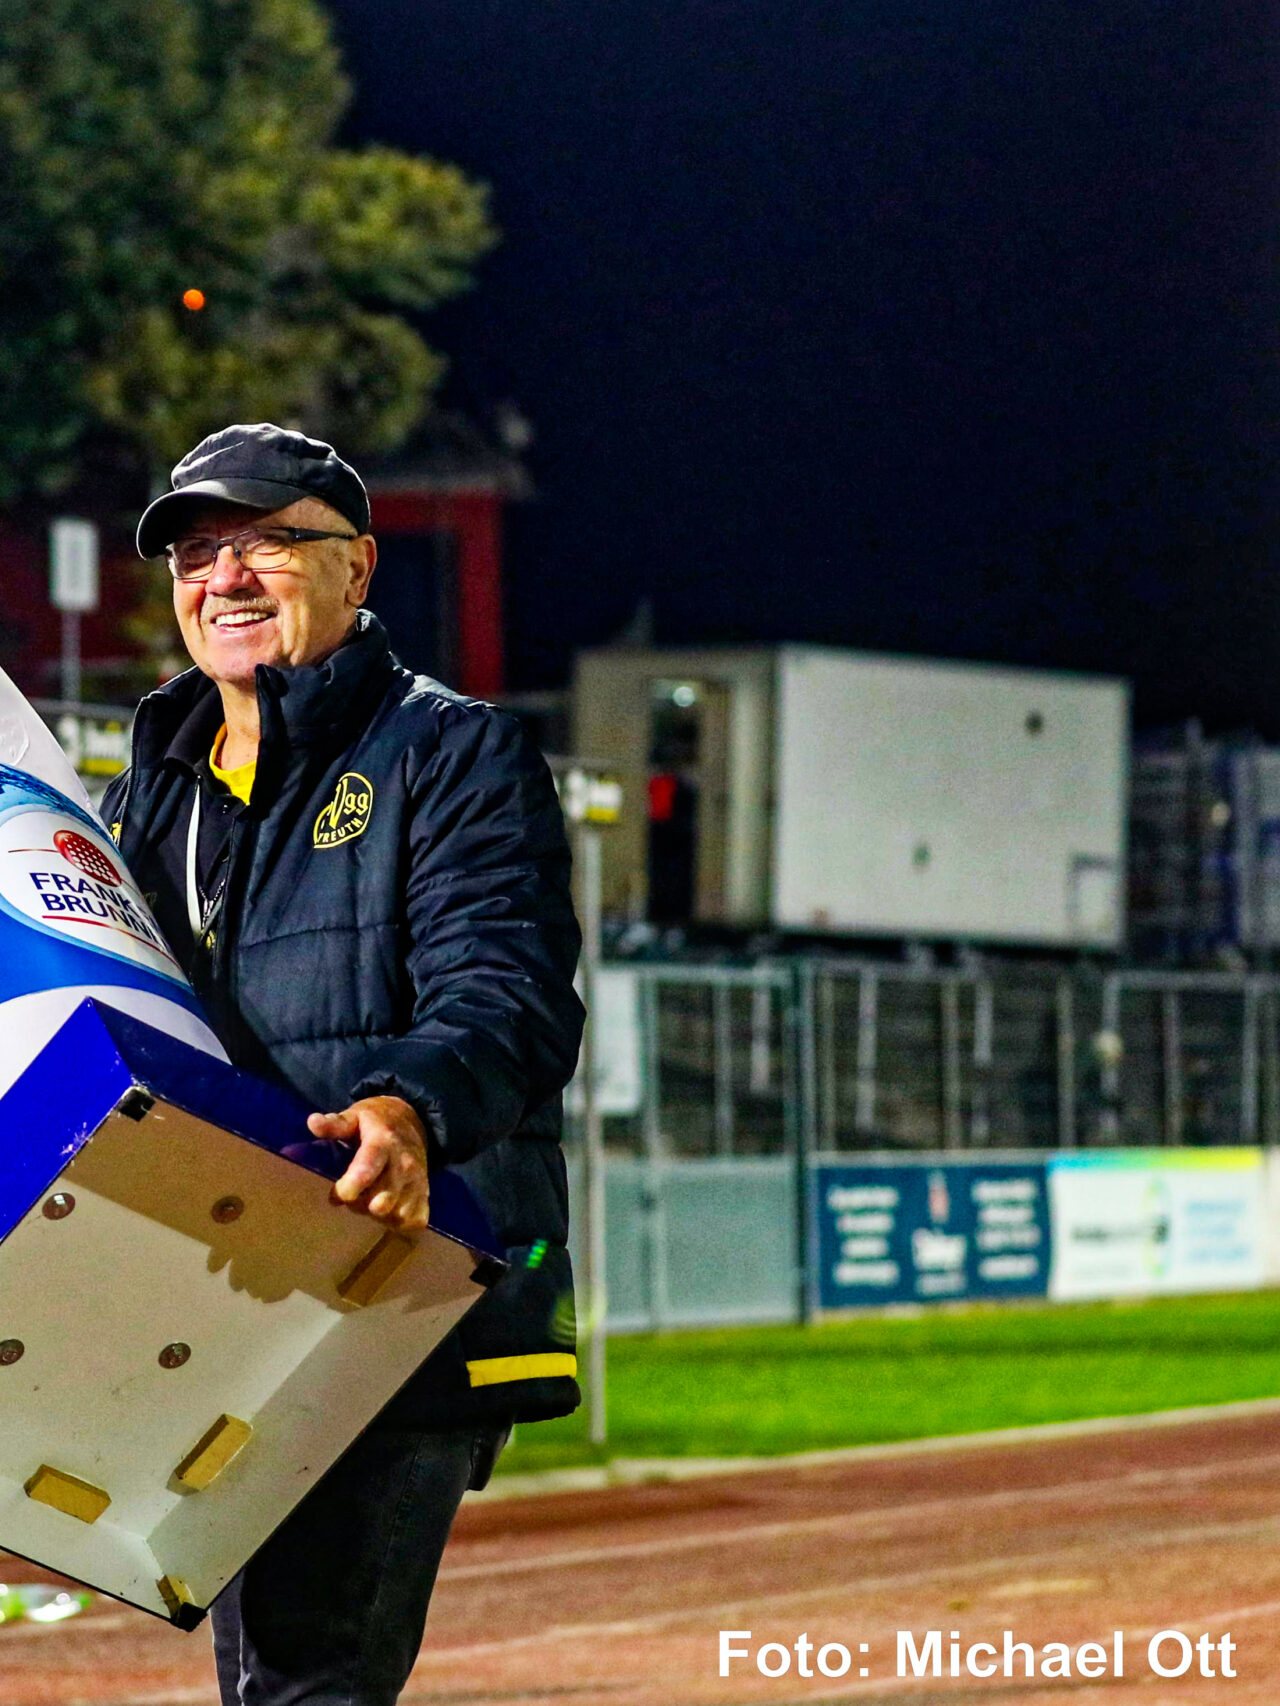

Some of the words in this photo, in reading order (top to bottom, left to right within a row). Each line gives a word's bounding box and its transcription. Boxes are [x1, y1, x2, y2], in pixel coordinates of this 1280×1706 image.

[318, 817, 363, 843] YREUTH
[29, 872, 159, 931] FRANK
[40, 893, 172, 953] BRUNN
